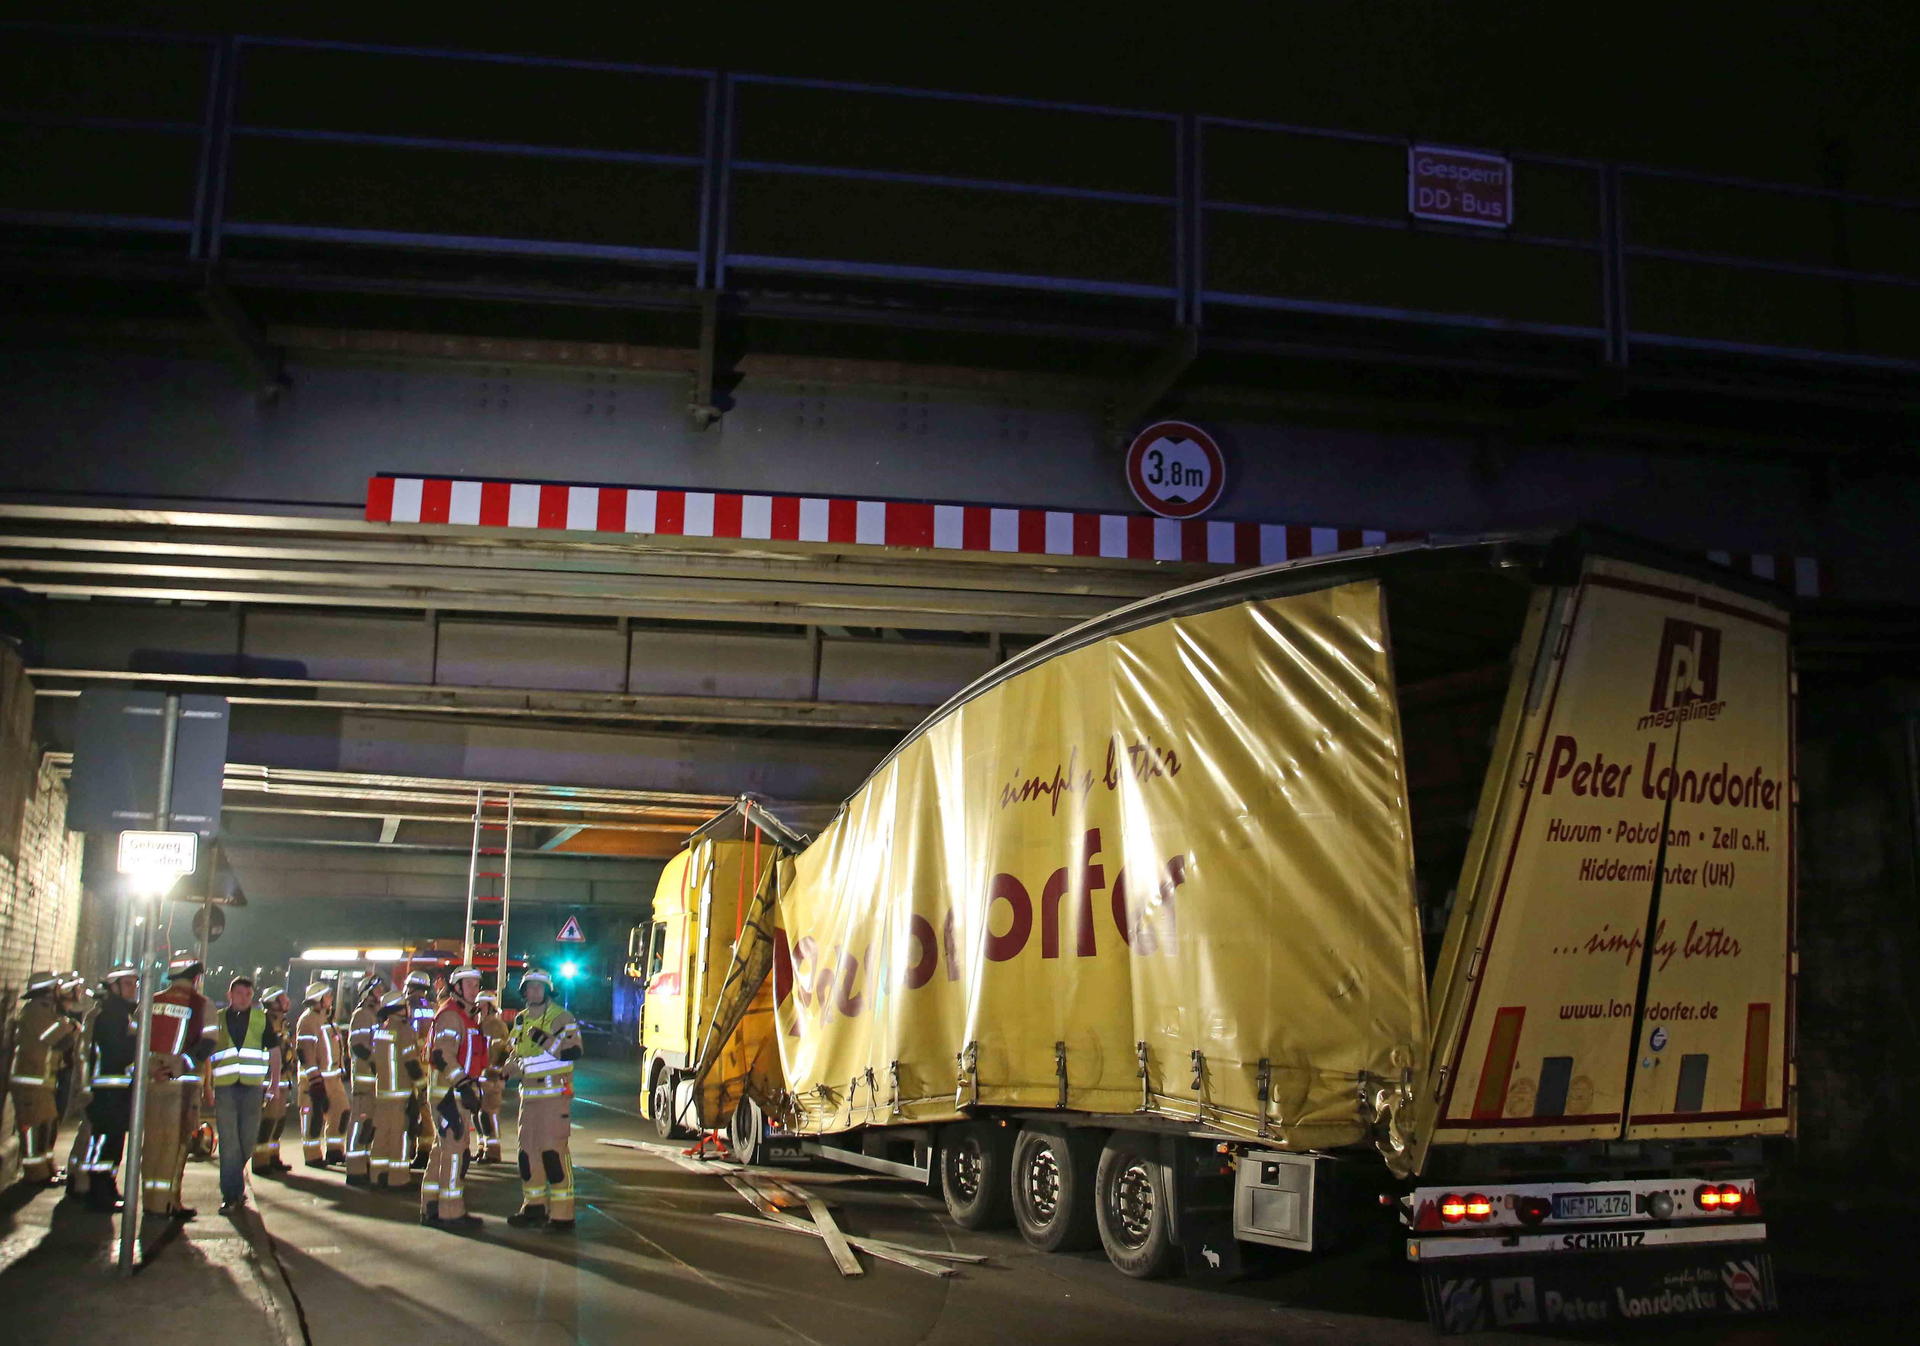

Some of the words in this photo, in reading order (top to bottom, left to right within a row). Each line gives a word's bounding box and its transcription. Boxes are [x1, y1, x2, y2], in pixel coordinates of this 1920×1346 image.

[1103, 735, 1182, 791] btter
[1542, 734, 1632, 798] Peter
[1641, 742, 1783, 812] Lonsdorfer
[1546, 818, 1602, 842] Husum
[1712, 826, 1738, 850] Zell
[1702, 860, 1735, 888] (UK)
[1683, 920, 1742, 958] better
[1562, 1197, 1579, 1216] NF
[1586, 1197, 1602, 1214] PL
[1604, 1196, 1629, 1213] 176
[1562, 1231, 1645, 1249] SCHMITZ
